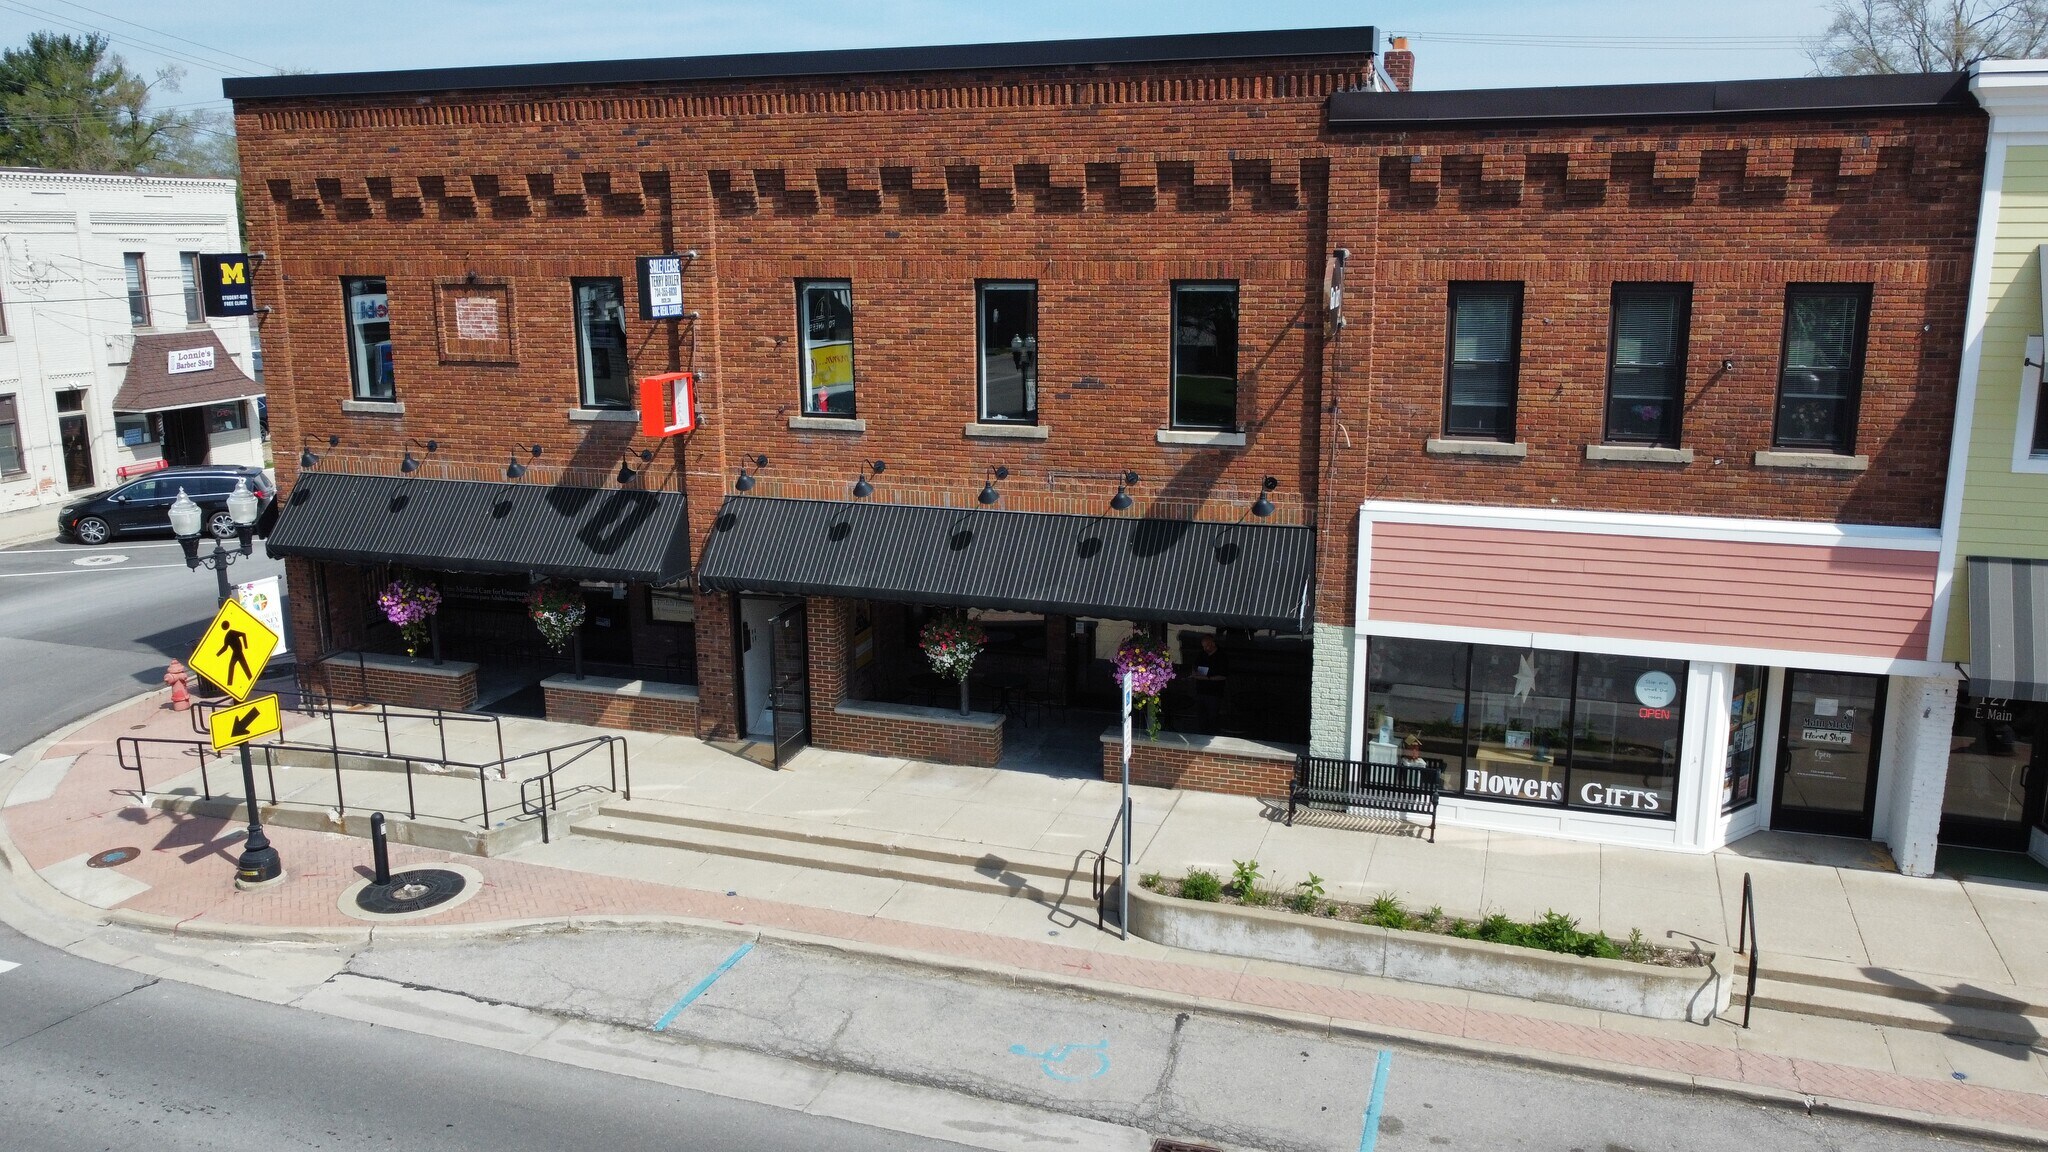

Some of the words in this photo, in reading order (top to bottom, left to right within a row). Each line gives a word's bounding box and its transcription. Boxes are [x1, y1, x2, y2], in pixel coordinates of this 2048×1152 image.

[220, 262, 246, 285] M
[651, 275, 664, 287] TERRY
[178, 350, 211, 361] Lonnie's
[176, 361, 197, 370] Barber
[198, 360, 213, 368] Shop
[455, 585, 478, 594] Medical
[478, 586, 492, 595] Care
[492, 587, 501, 595] for
[1638, 707, 1670, 720] OPEN
[1975, 707, 1984, 719] E.
[1987, 708, 2013, 721] Main
[1803, 718, 1826, 728] Main
[1804, 731, 1828, 740] Floral
[1829, 732, 1847, 743] Shop
[1814, 749, 1832, 760] Open
[1465, 769, 1563, 801] Flowers
[1580, 782, 1660, 810] GIFTS
